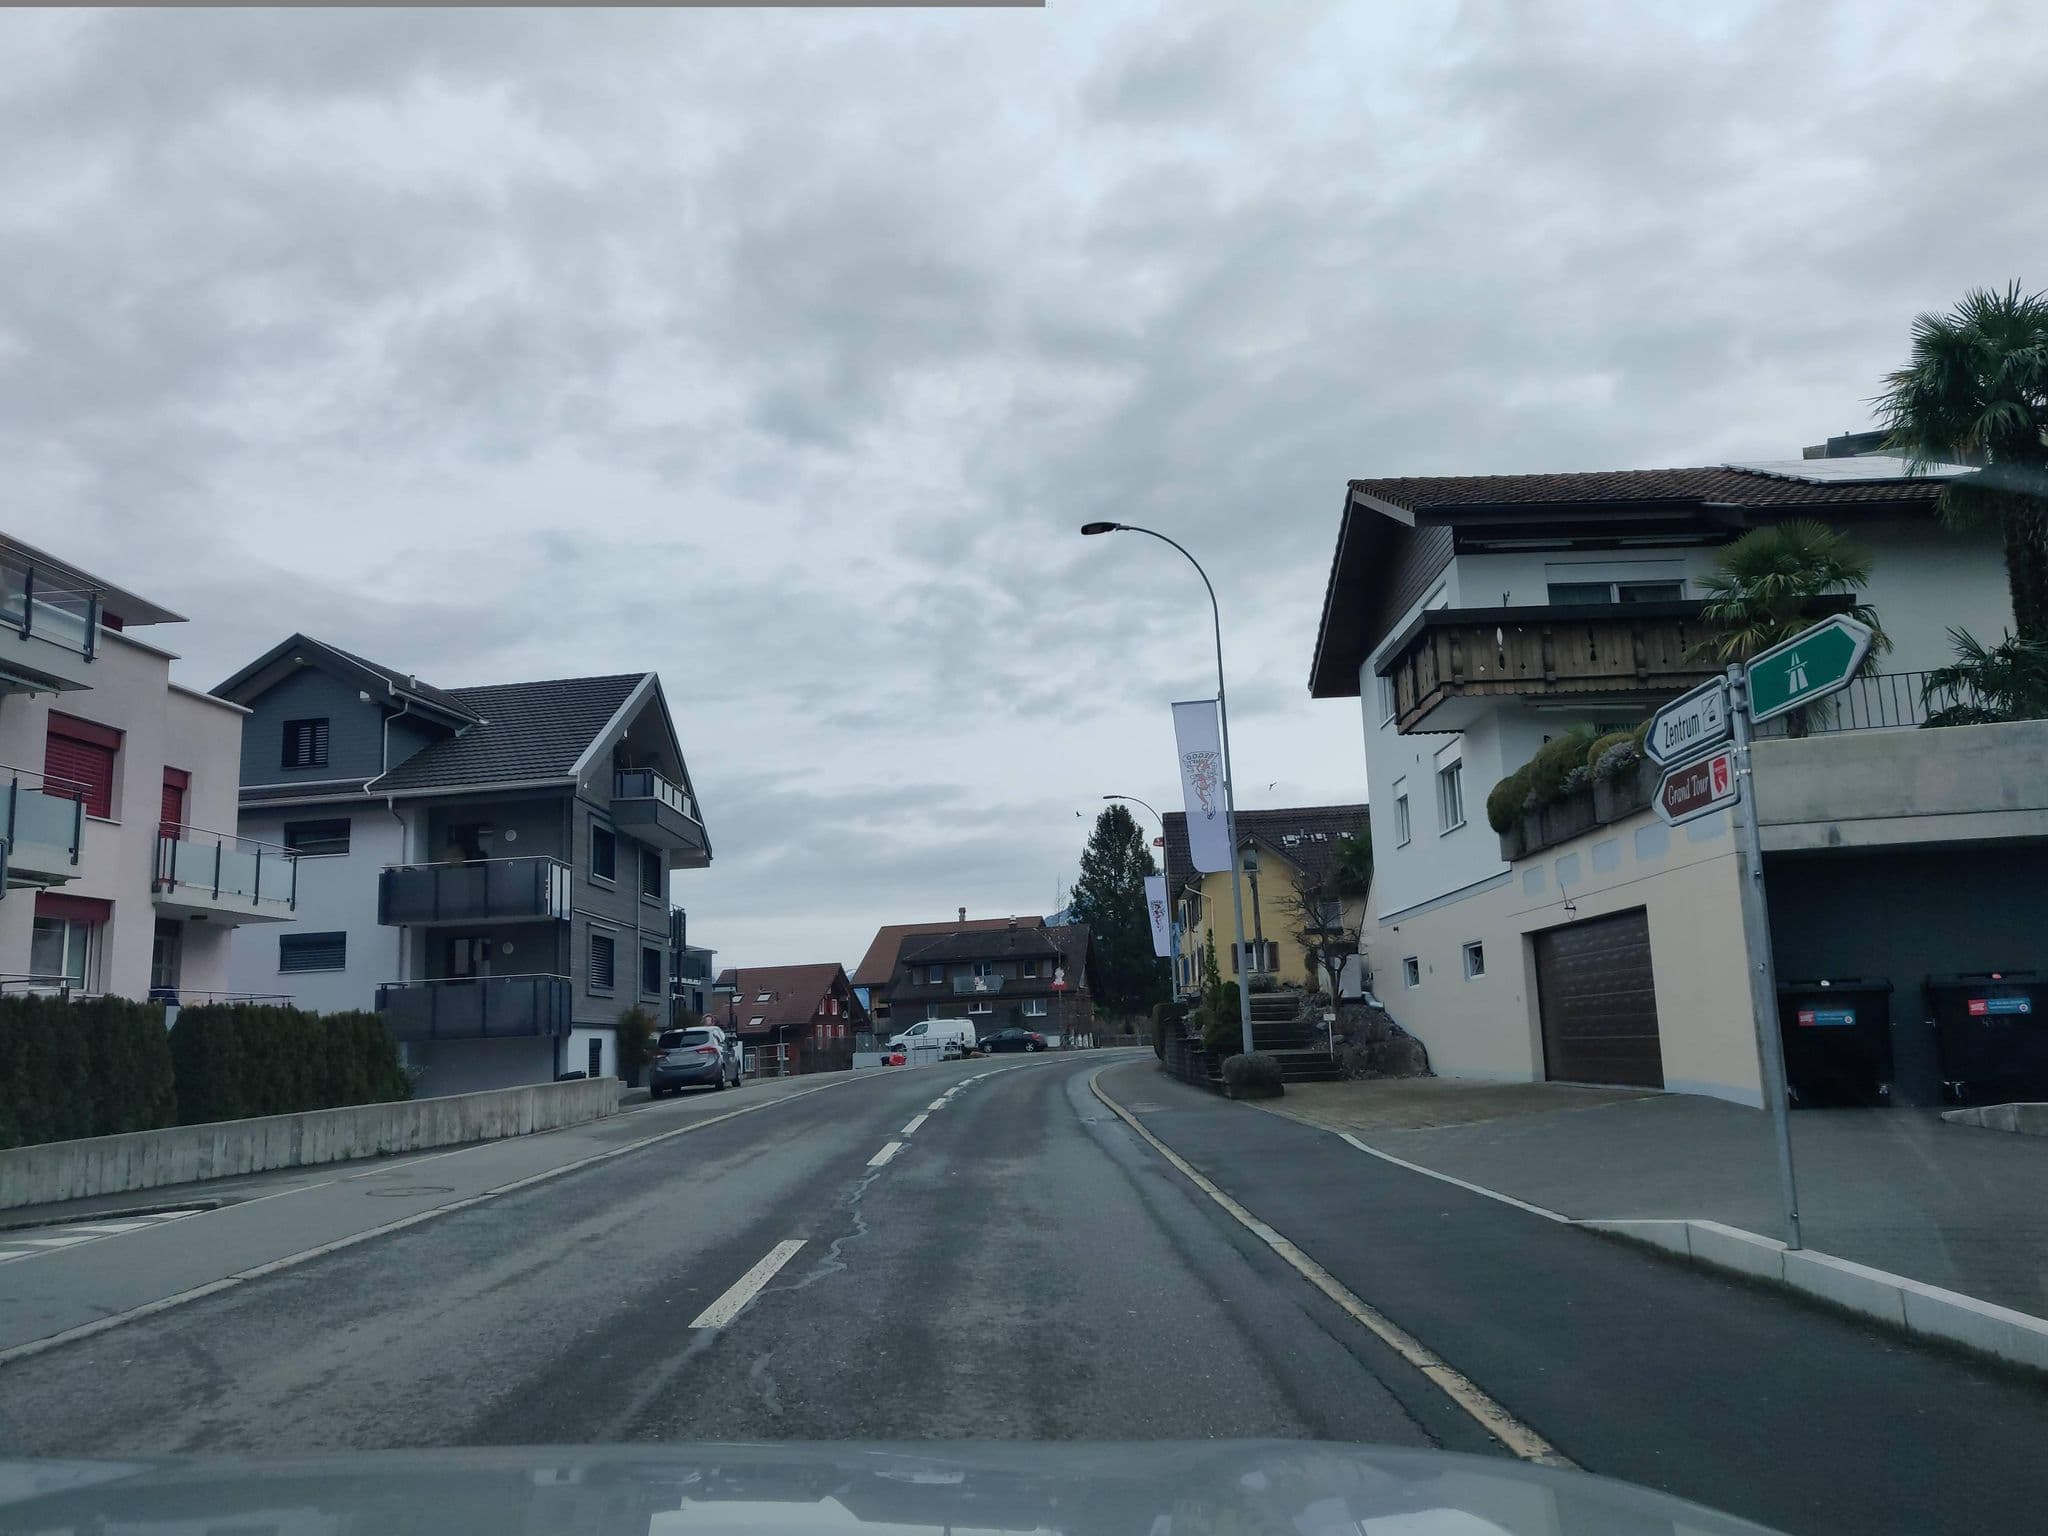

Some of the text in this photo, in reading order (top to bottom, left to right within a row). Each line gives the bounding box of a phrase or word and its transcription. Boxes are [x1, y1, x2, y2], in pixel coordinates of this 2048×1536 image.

[1663, 714, 1700, 749] Zentrum
[1668, 774, 1709, 806] Grand Tour
